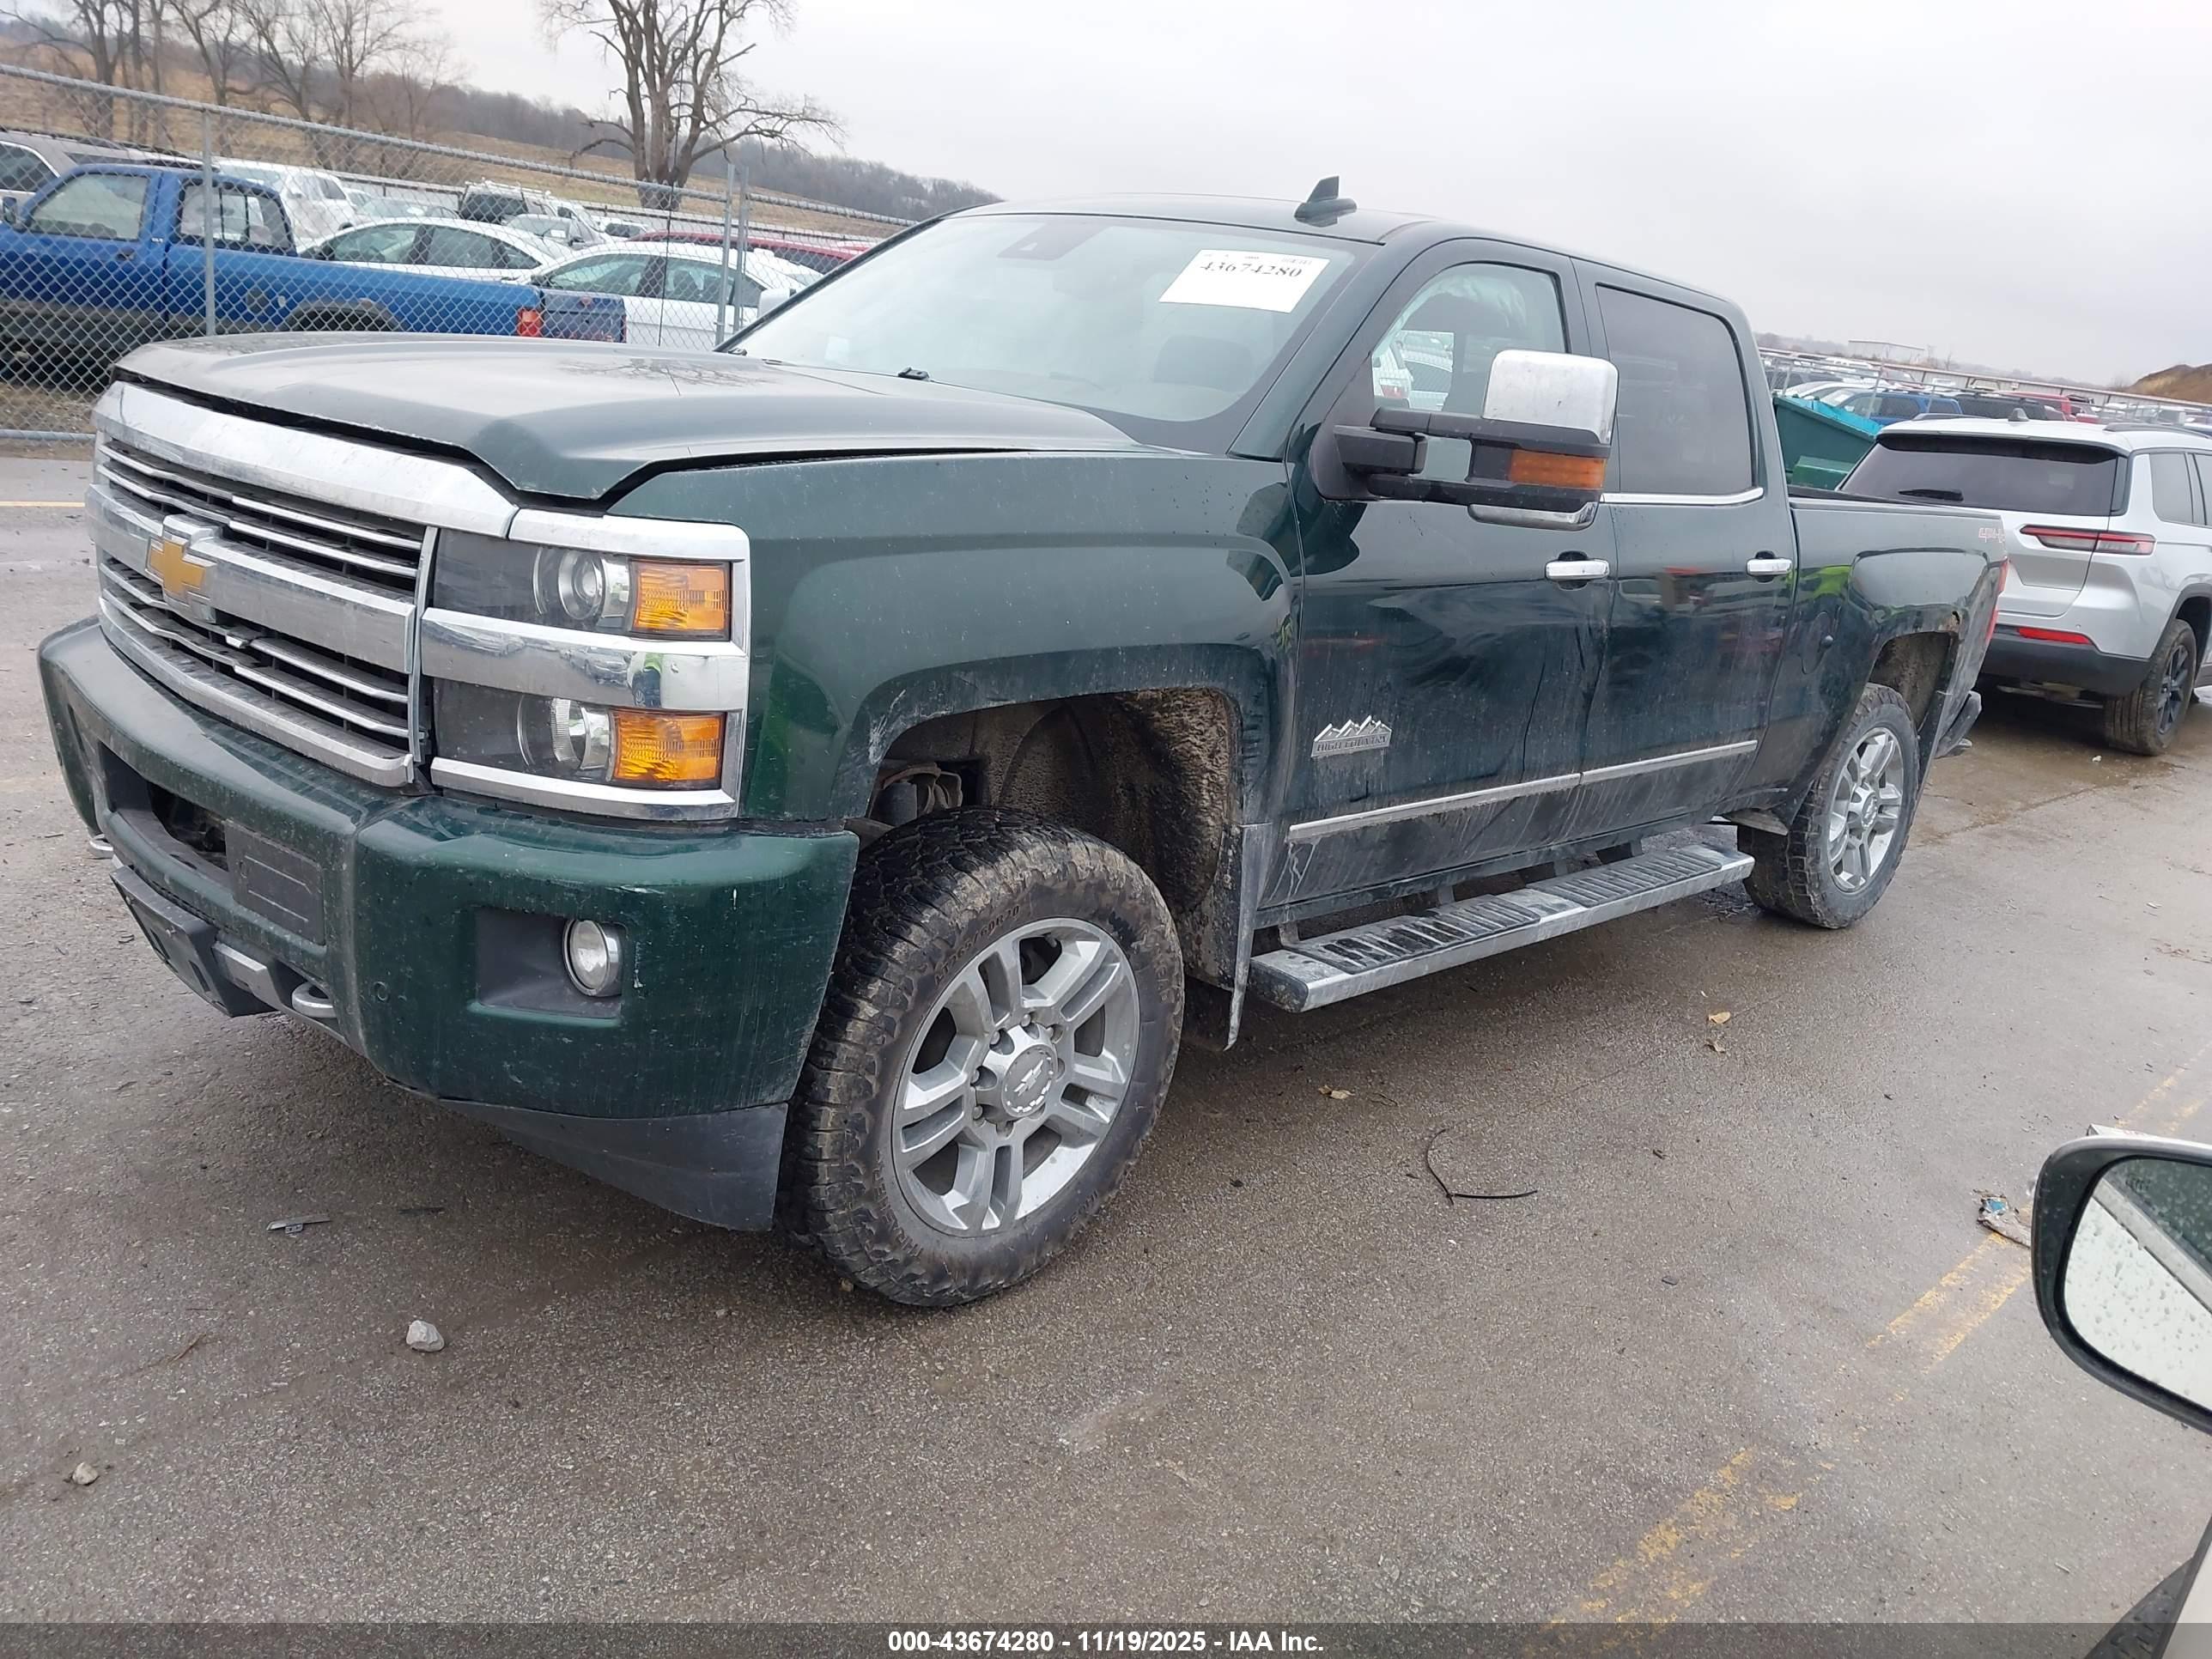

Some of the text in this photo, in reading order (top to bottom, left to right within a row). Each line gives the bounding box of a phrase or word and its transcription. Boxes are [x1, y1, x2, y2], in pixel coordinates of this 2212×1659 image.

[1200, 262, 1303, 276] 43674280
[1317, 735, 1387, 752] HIGH COUNTRY
